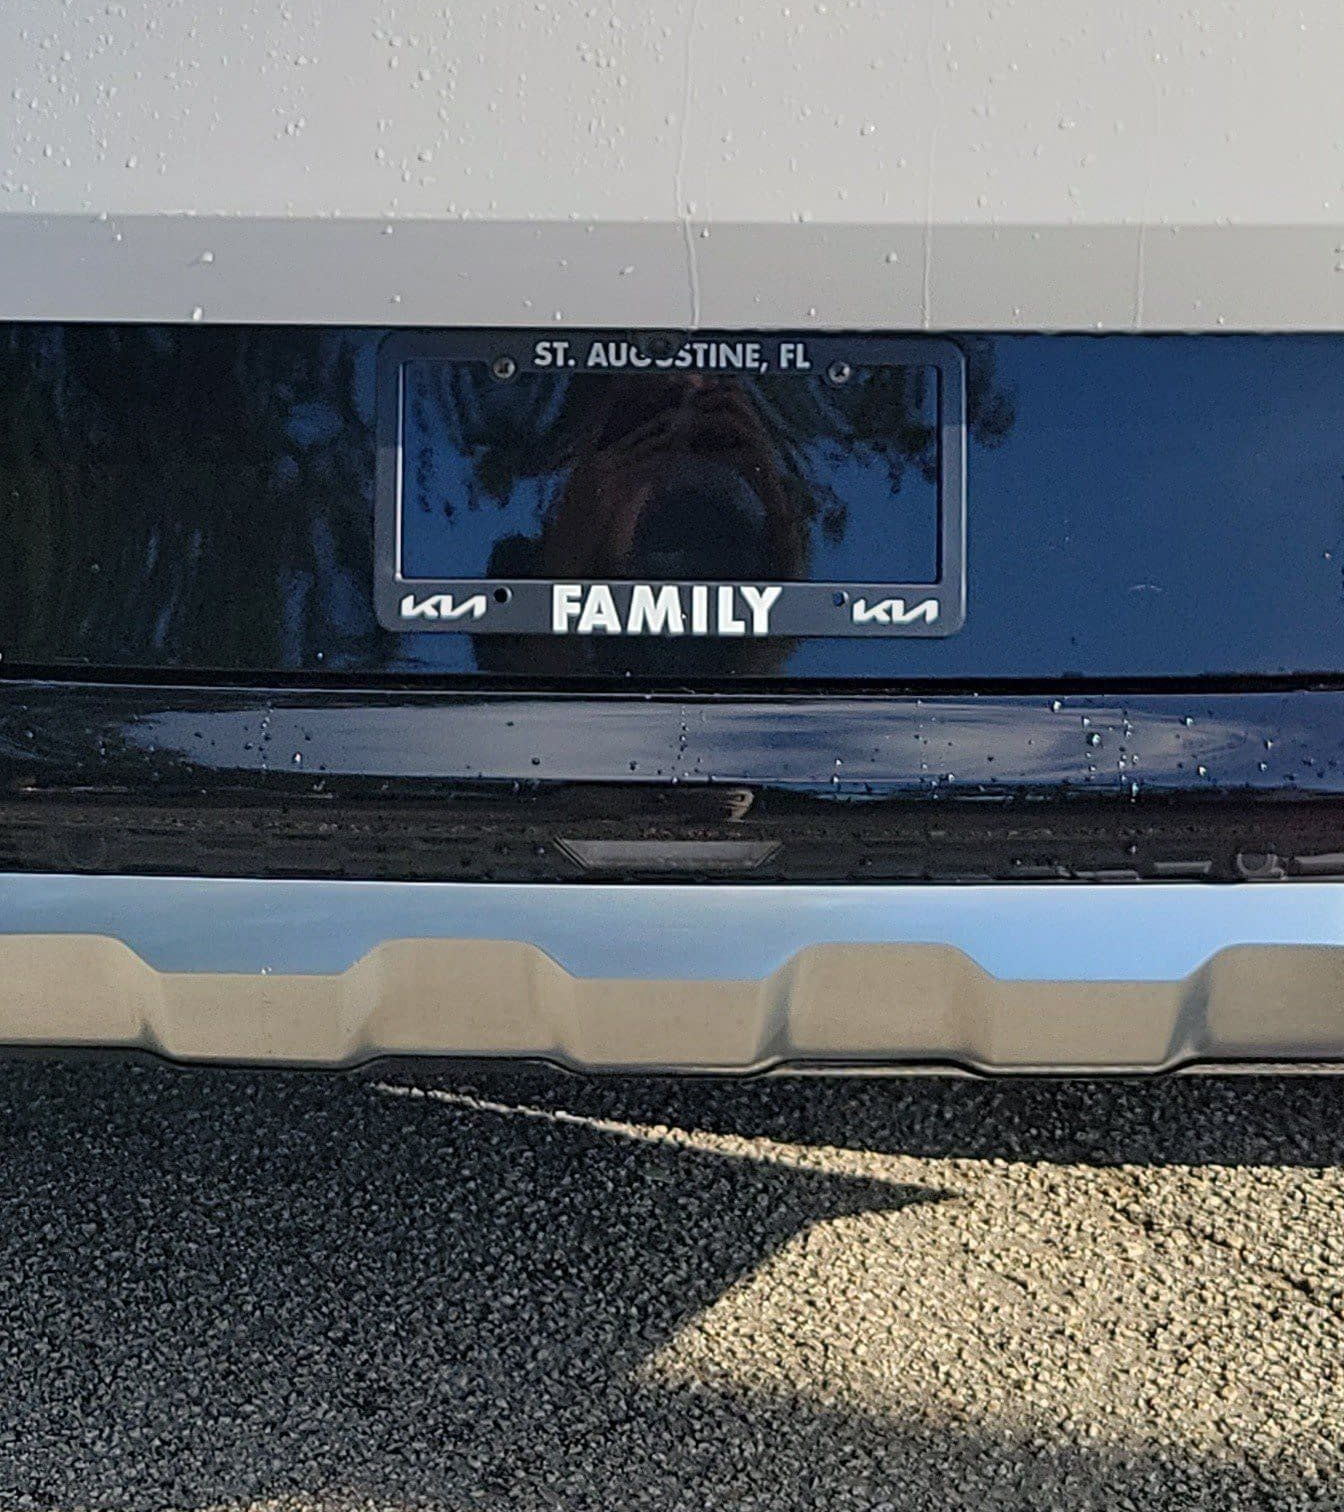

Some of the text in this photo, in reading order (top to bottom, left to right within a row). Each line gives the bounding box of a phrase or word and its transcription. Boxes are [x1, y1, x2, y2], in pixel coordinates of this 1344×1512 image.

[533, 341, 576, 367] ST.
[779, 342, 811, 369] FL
[401, 583, 939, 636] KIA FAMILY KIA
